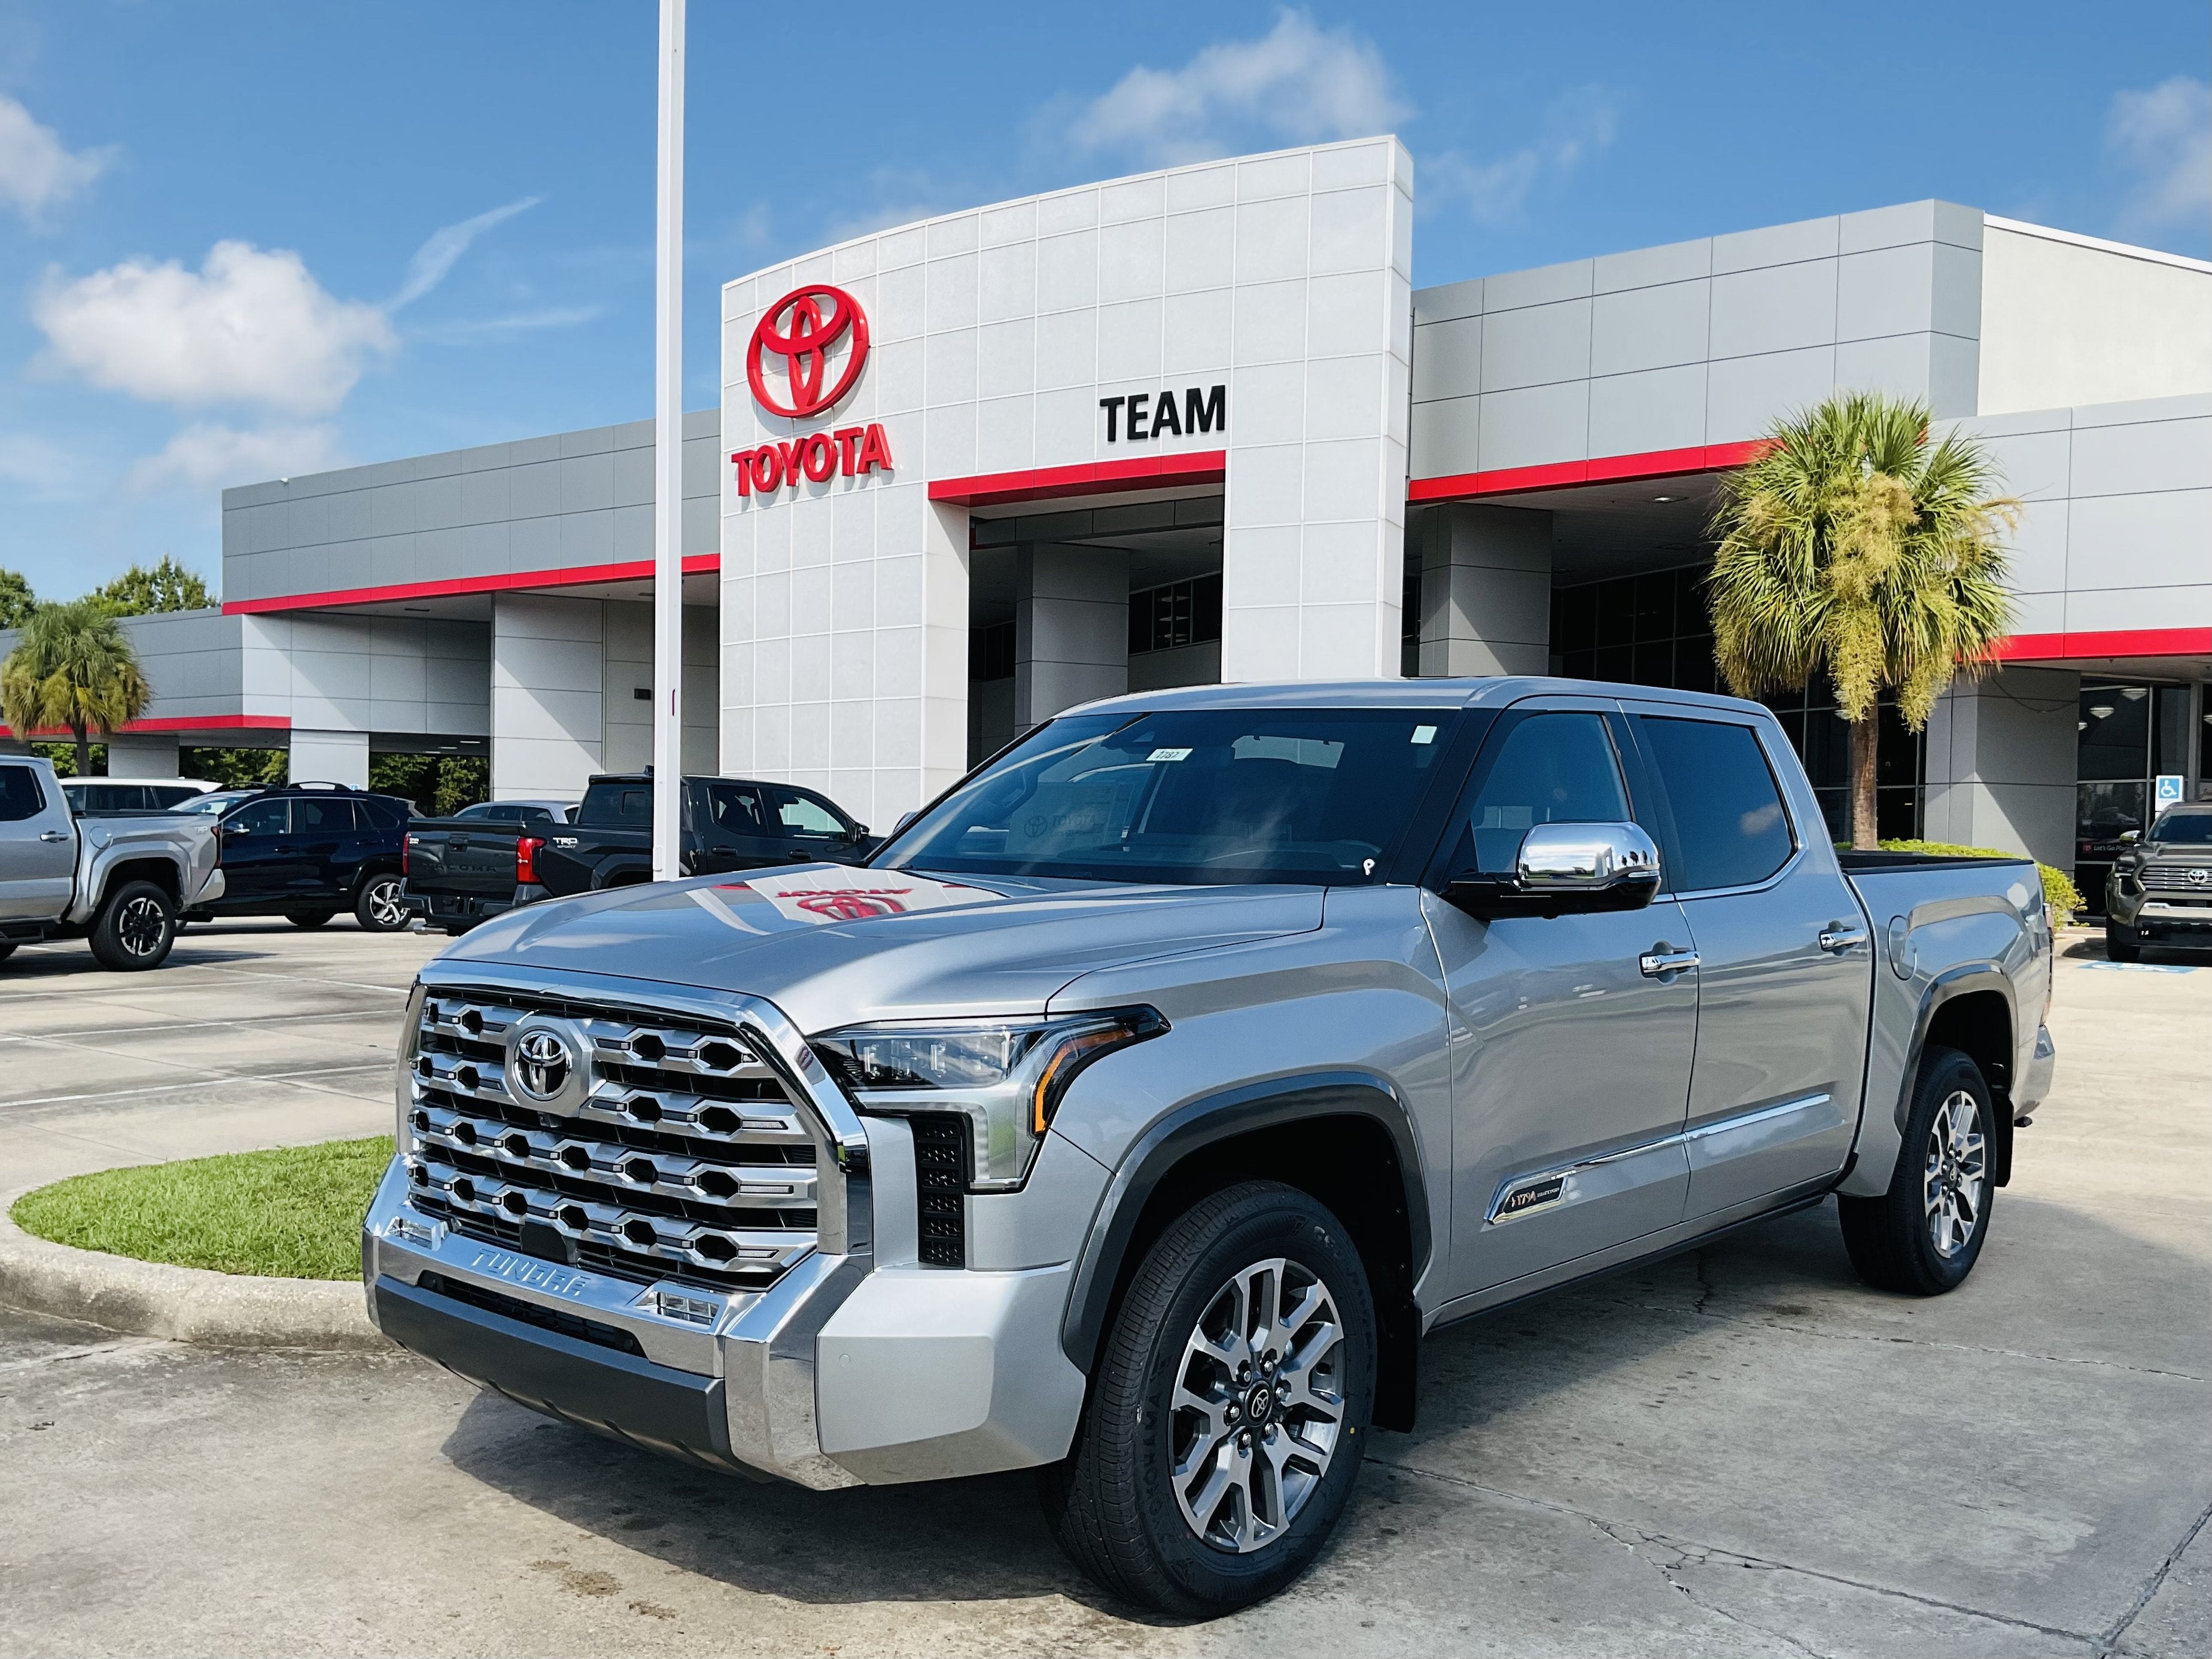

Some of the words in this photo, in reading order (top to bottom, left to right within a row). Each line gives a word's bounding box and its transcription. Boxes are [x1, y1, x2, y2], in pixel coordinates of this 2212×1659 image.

[1100, 385, 1225, 442] TEAM
[731, 423, 893, 496] TOYOTA
[1517, 1191, 1536, 1205] 1794
[472, 1248, 591, 1296] TUNDRA
